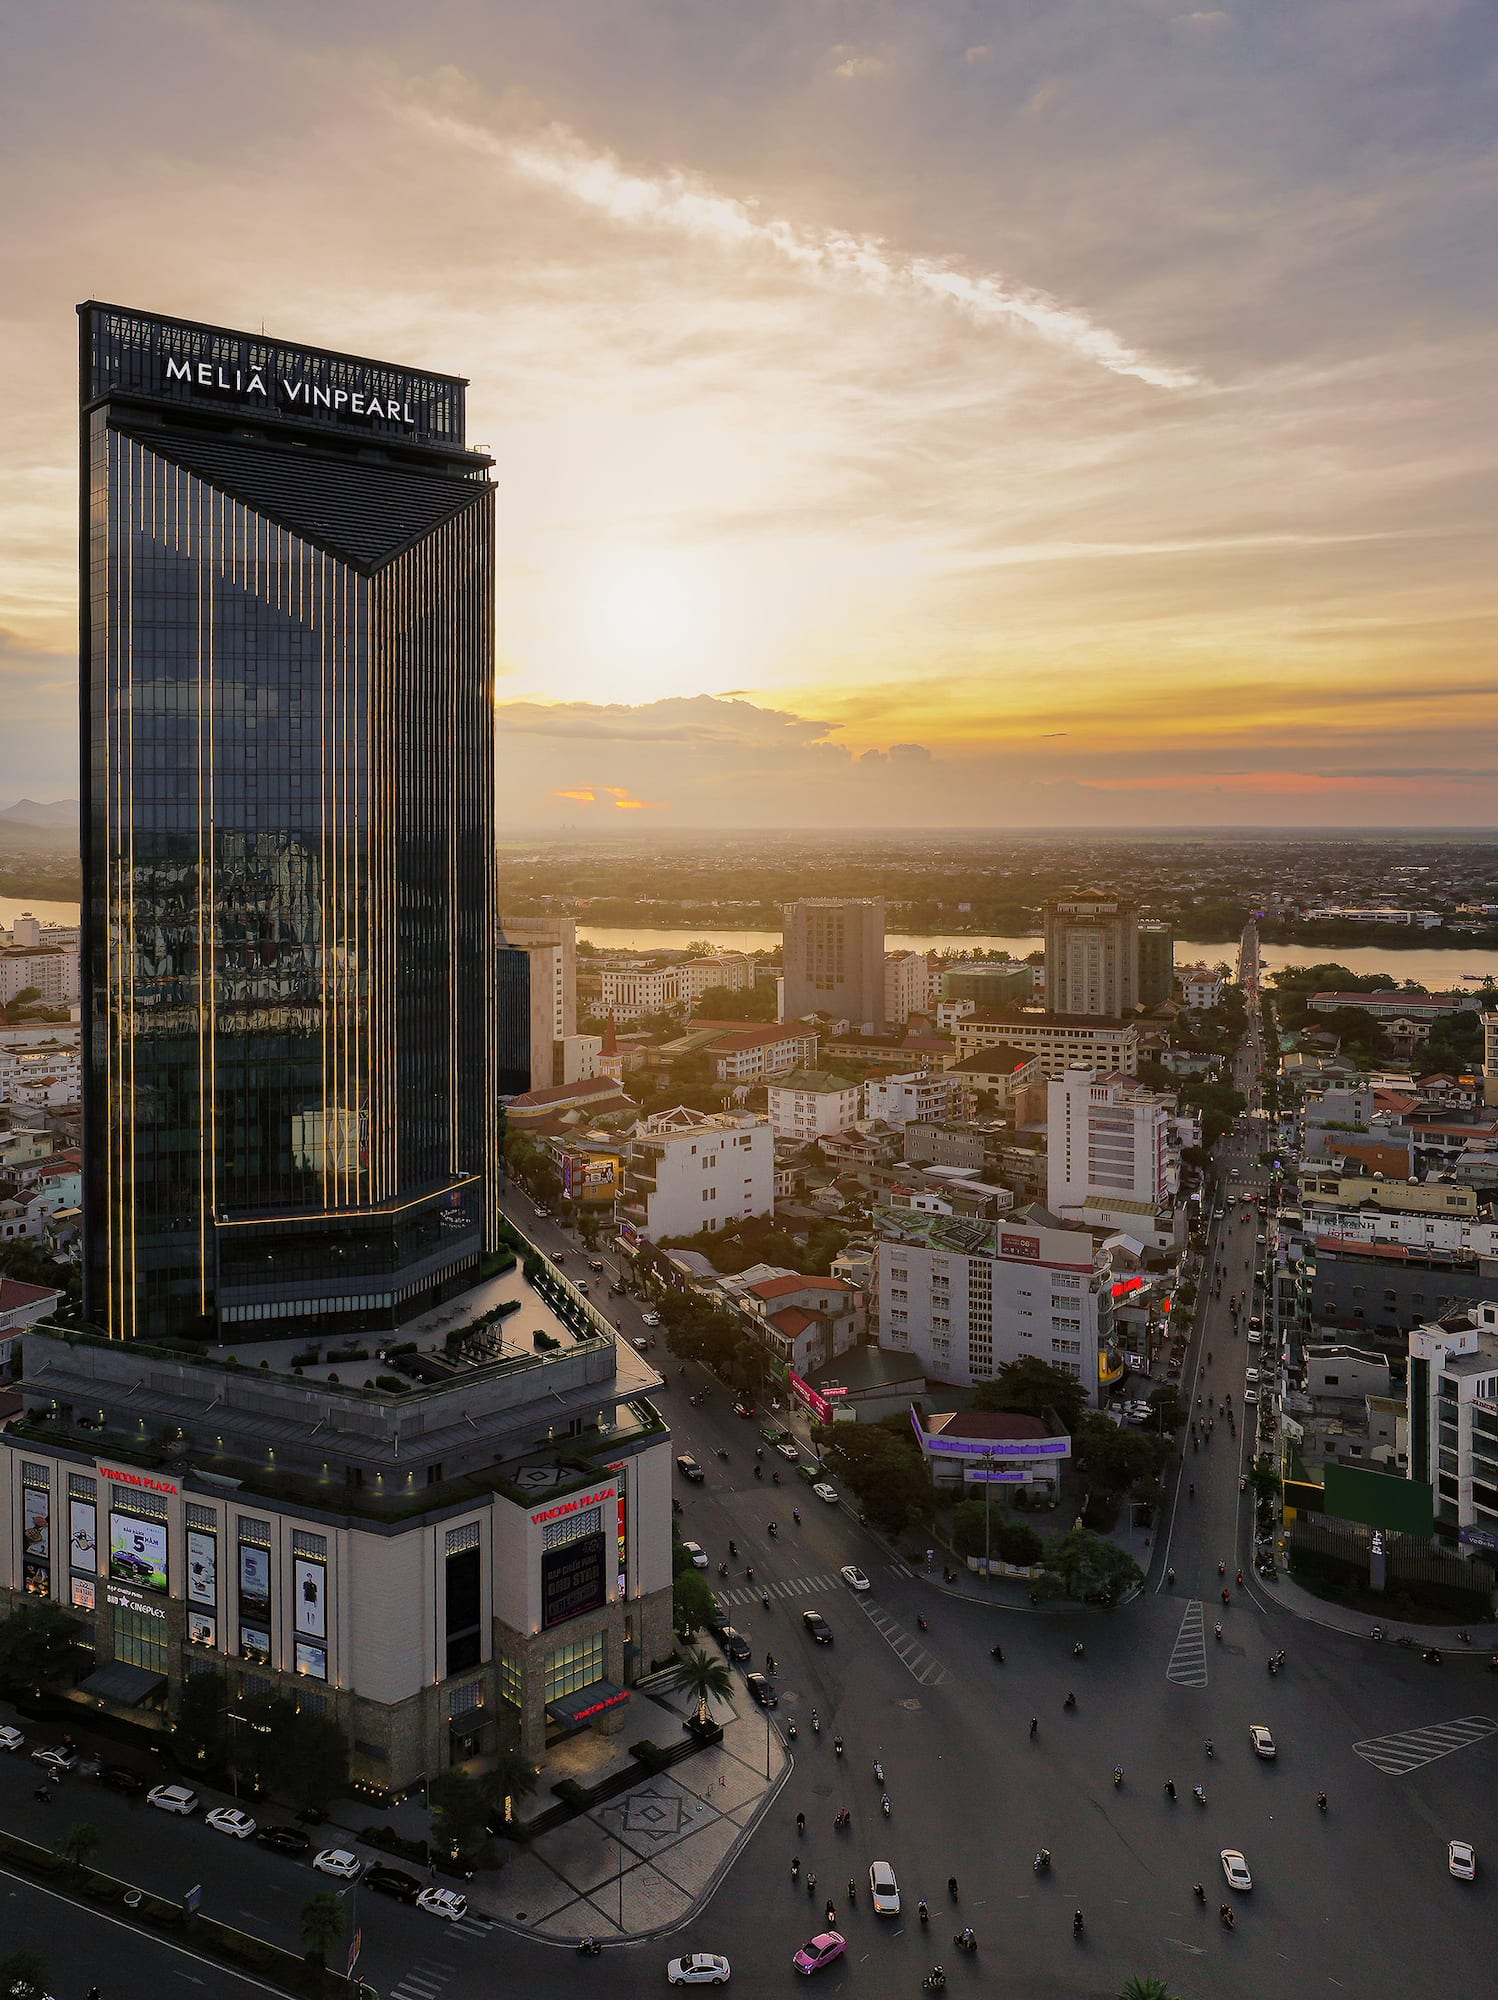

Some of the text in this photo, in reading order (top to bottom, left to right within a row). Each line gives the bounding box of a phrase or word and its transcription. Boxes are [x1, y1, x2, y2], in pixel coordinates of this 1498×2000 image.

[283, 379, 415, 424] VINPEARL
[99, 1467, 178, 1495] VINCOM PLAZA
[532, 1487, 615, 1525] VINCOM PLAZA
[133, 1534, 145, 1553] 5
[245, 1558, 257, 1577] 5
[130, 1601, 165, 1619] CINEPLEX
